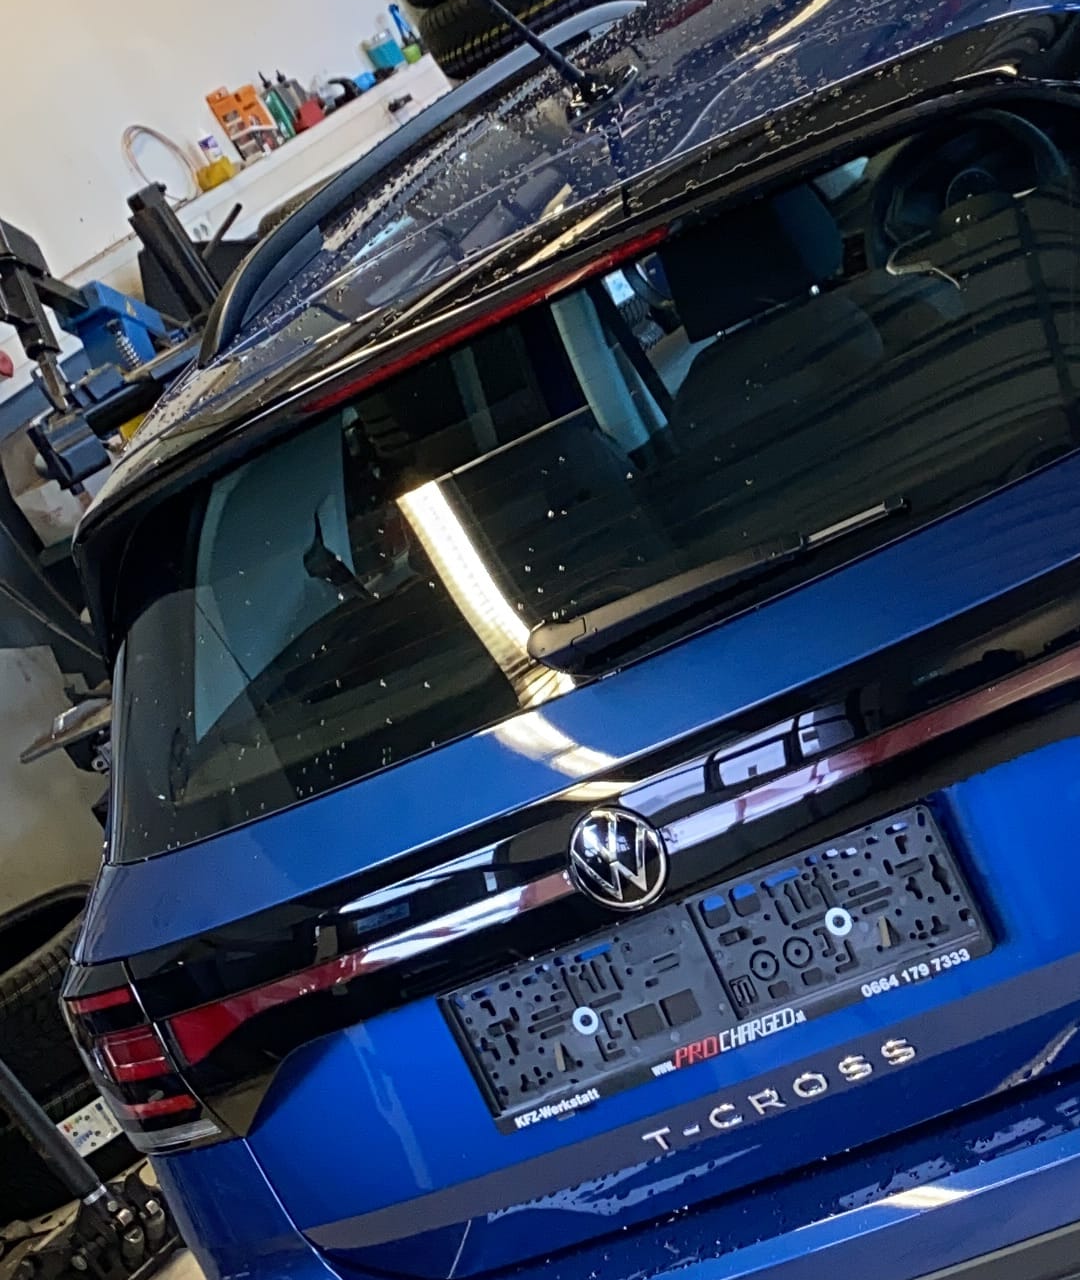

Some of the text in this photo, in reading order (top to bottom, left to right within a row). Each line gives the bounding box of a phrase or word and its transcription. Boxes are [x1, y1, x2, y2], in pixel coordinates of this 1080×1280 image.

[570, 808, 667, 909] VW
[861, 948, 970, 998] 0664 179 7333
[514, 1087, 600, 1129] KFZ-Werkstatt
[641, 1038, 916, 1151] T-CROSS
